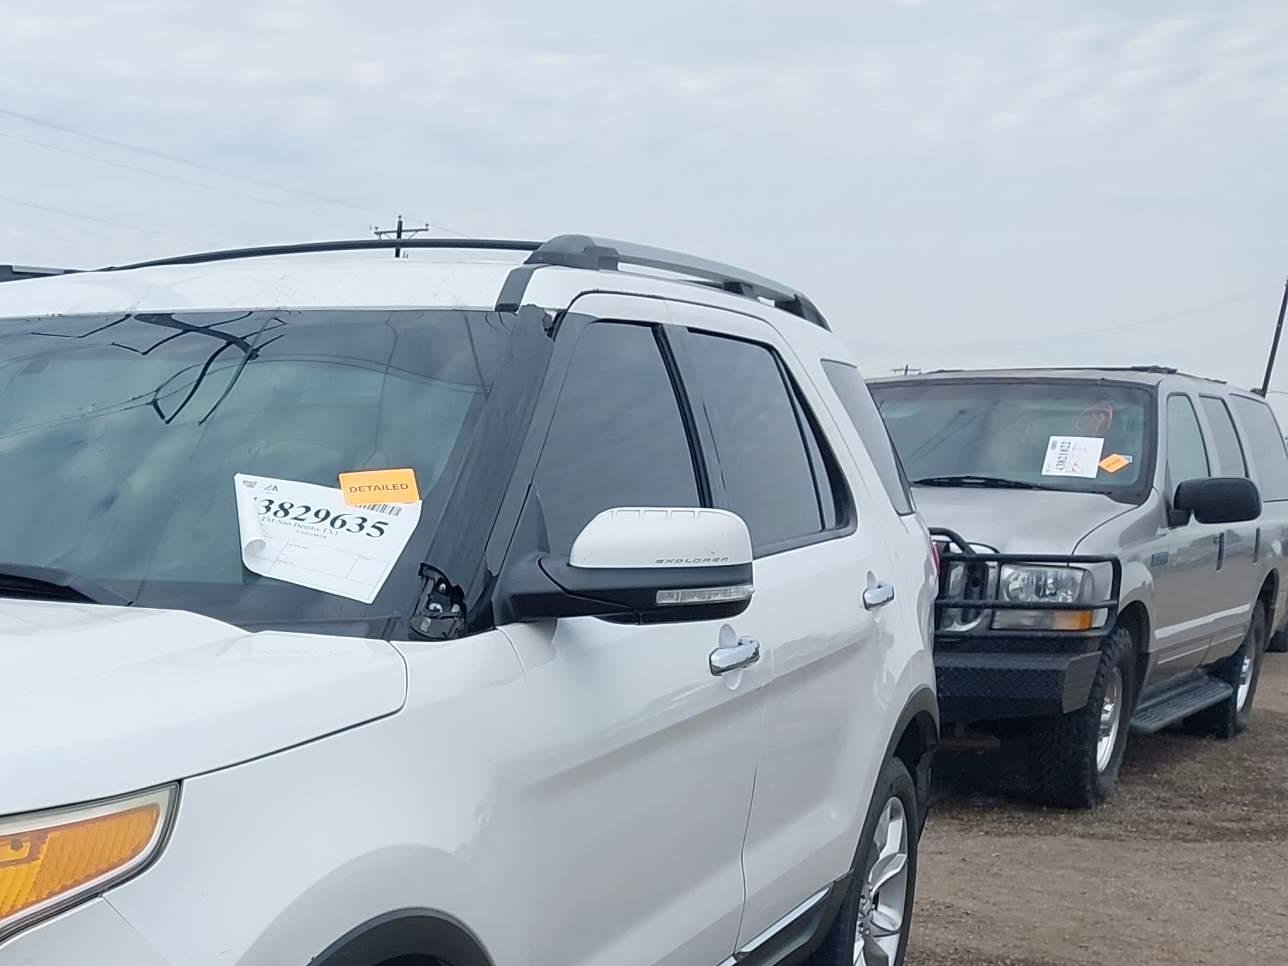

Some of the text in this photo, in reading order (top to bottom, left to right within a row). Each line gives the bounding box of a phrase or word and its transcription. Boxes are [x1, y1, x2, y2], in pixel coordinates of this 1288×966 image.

[348, 482, 409, 494] DETAILED
[253, 497, 389, 538] 3829635
[655, 556, 729, 564] EXPLORER
